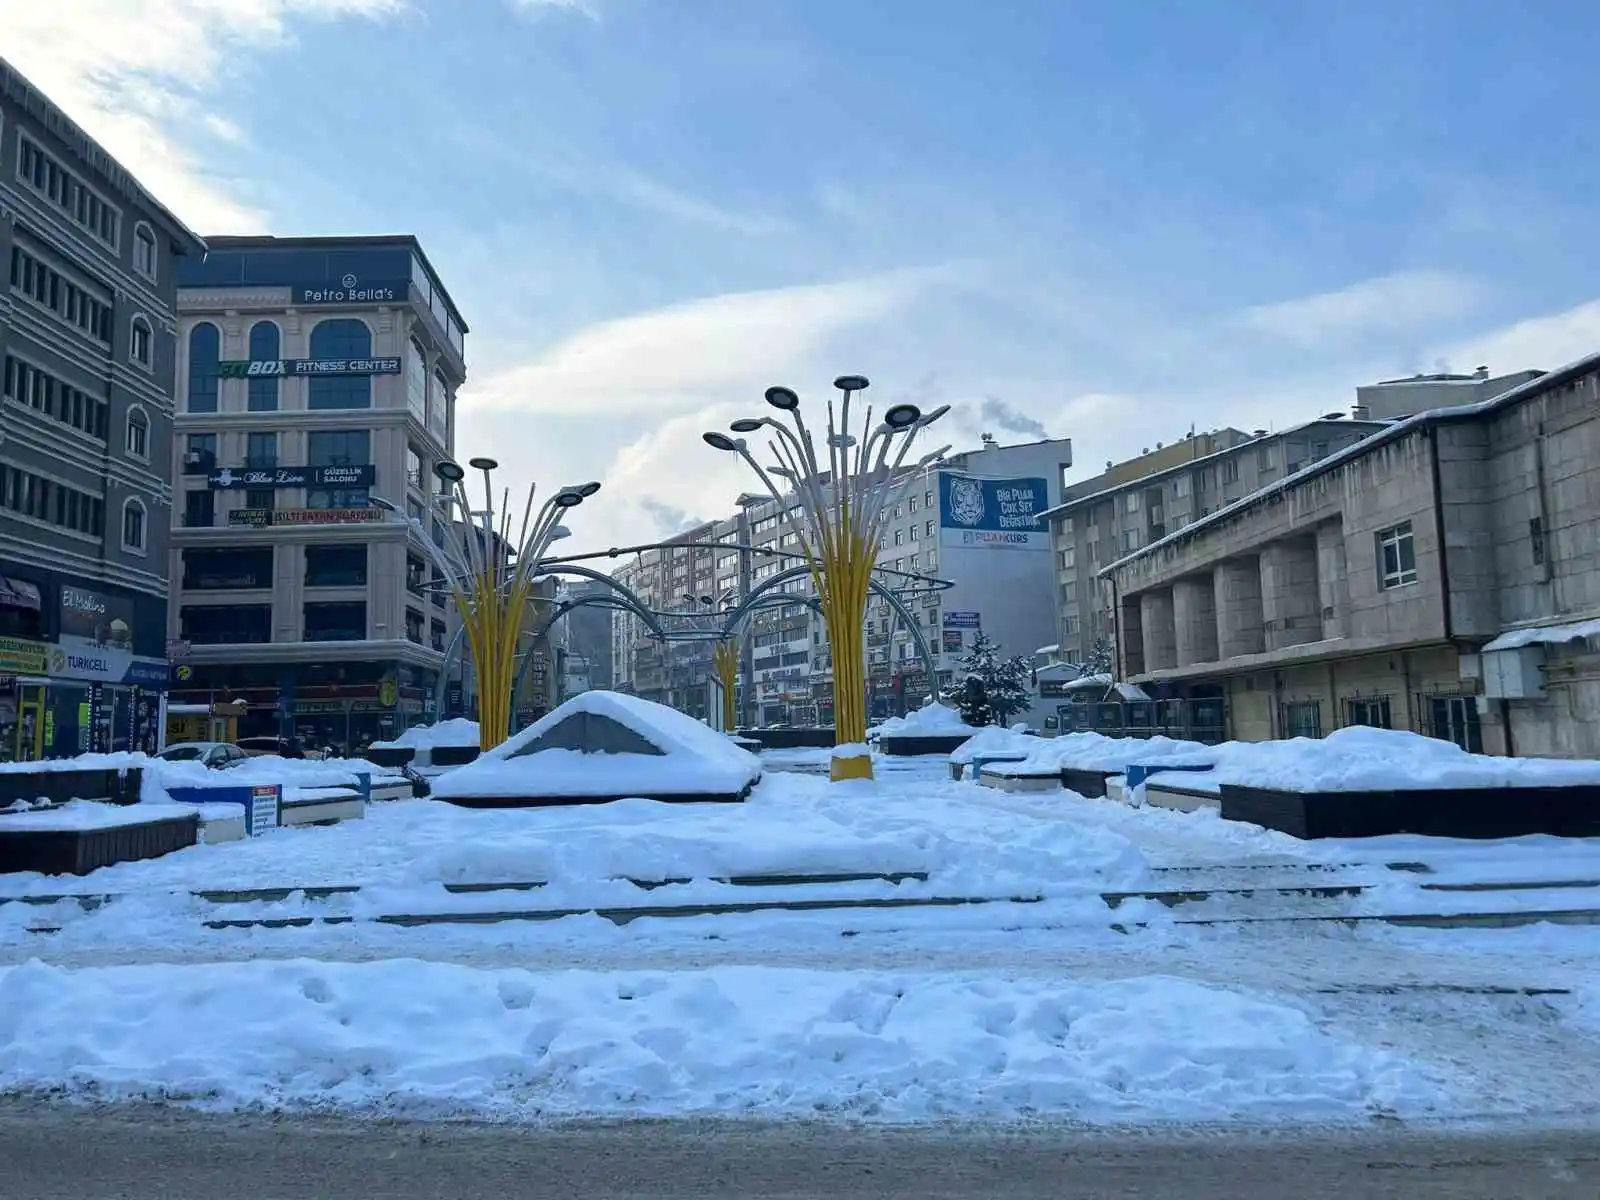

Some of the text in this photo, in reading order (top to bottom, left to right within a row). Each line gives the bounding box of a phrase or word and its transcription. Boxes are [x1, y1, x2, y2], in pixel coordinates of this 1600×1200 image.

[304, 287, 393, 301] Petro Bella's
[296, 361, 346, 372] FITNESS
[349, 359, 398, 371] CENTER
[67, 655, 109, 673] TURKCELL
